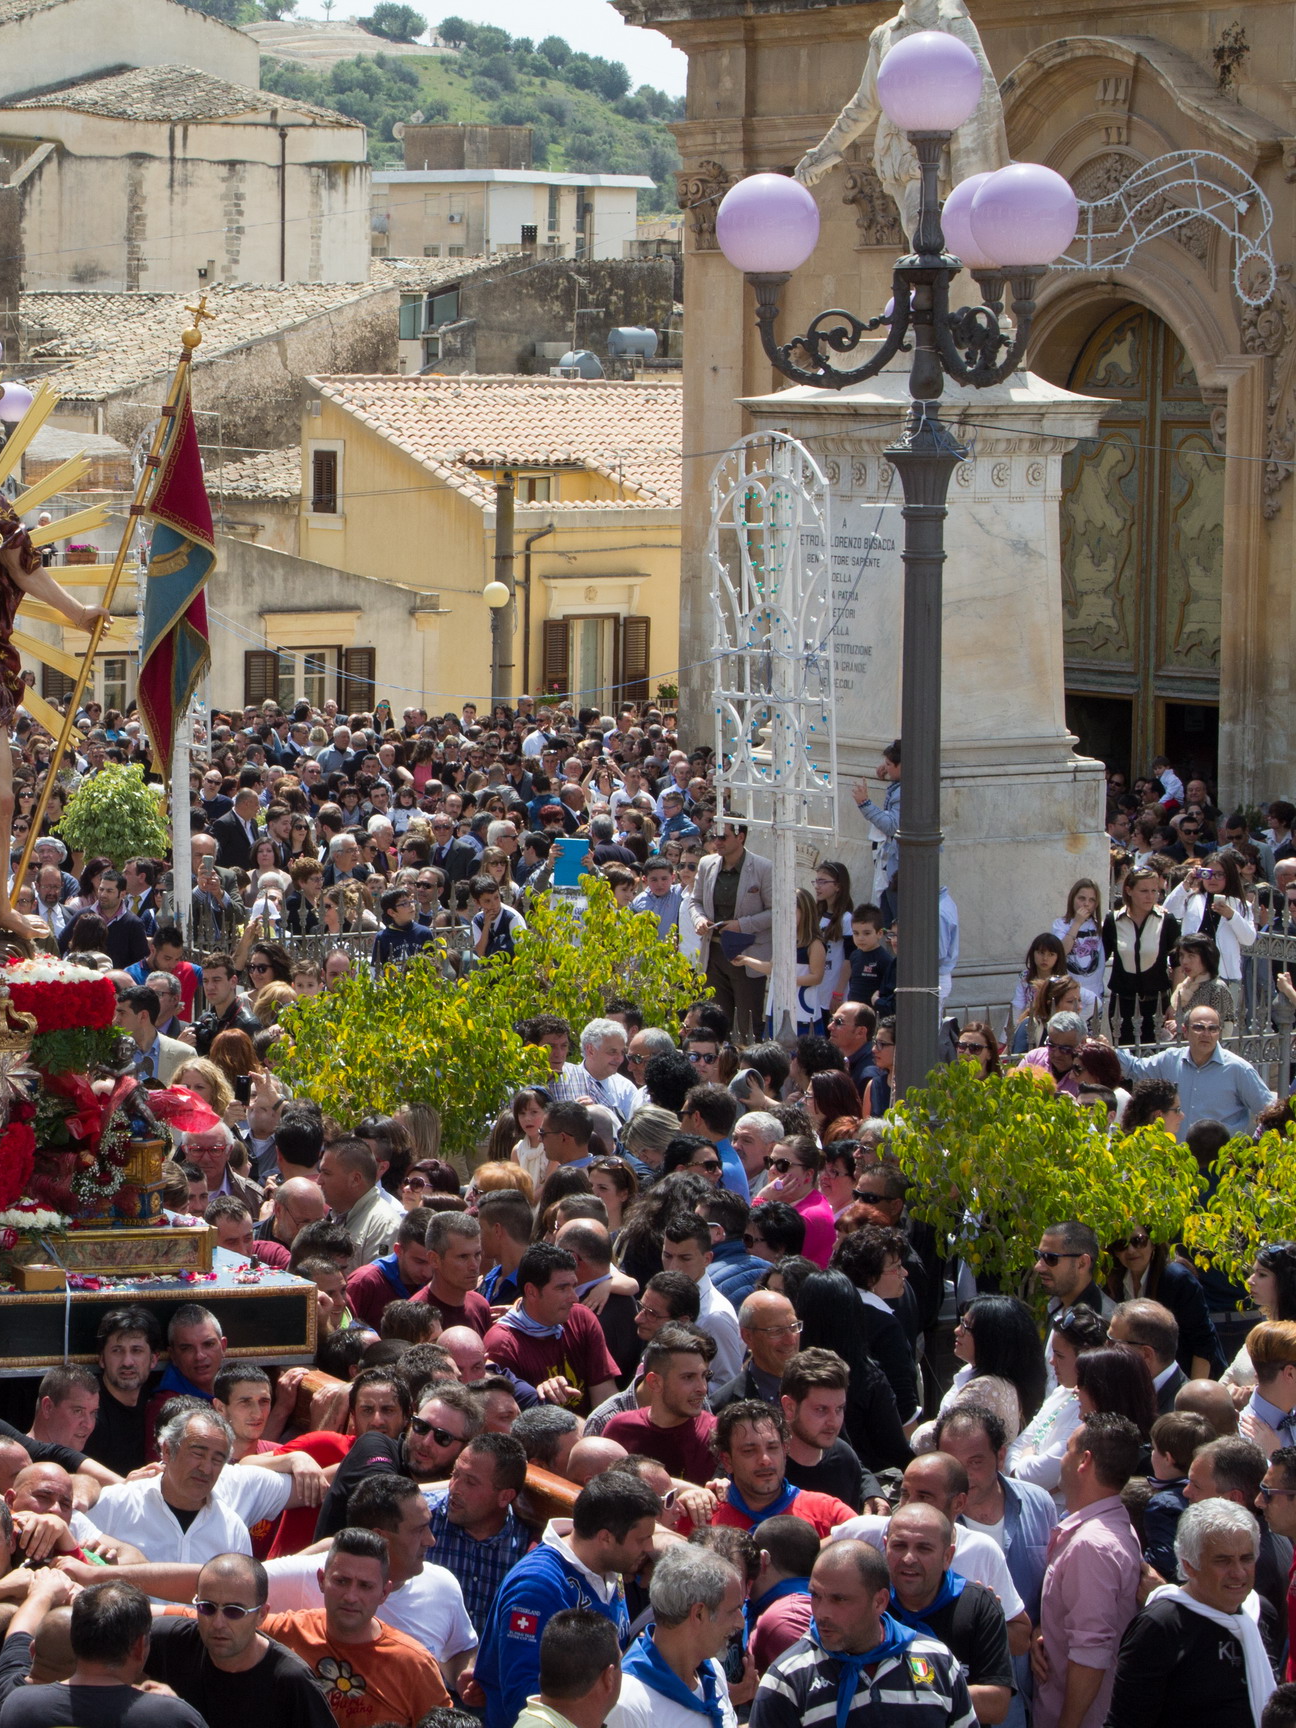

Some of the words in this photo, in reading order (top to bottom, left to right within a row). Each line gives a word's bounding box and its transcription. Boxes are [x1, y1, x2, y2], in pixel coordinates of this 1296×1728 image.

[842, 517, 847, 529] A
[830, 536, 861, 549] ORENZO
[832, 626, 849, 636] ELLA
[842, 661, 866, 673] GRANDE
[834, 679, 854, 690] ECOLI
